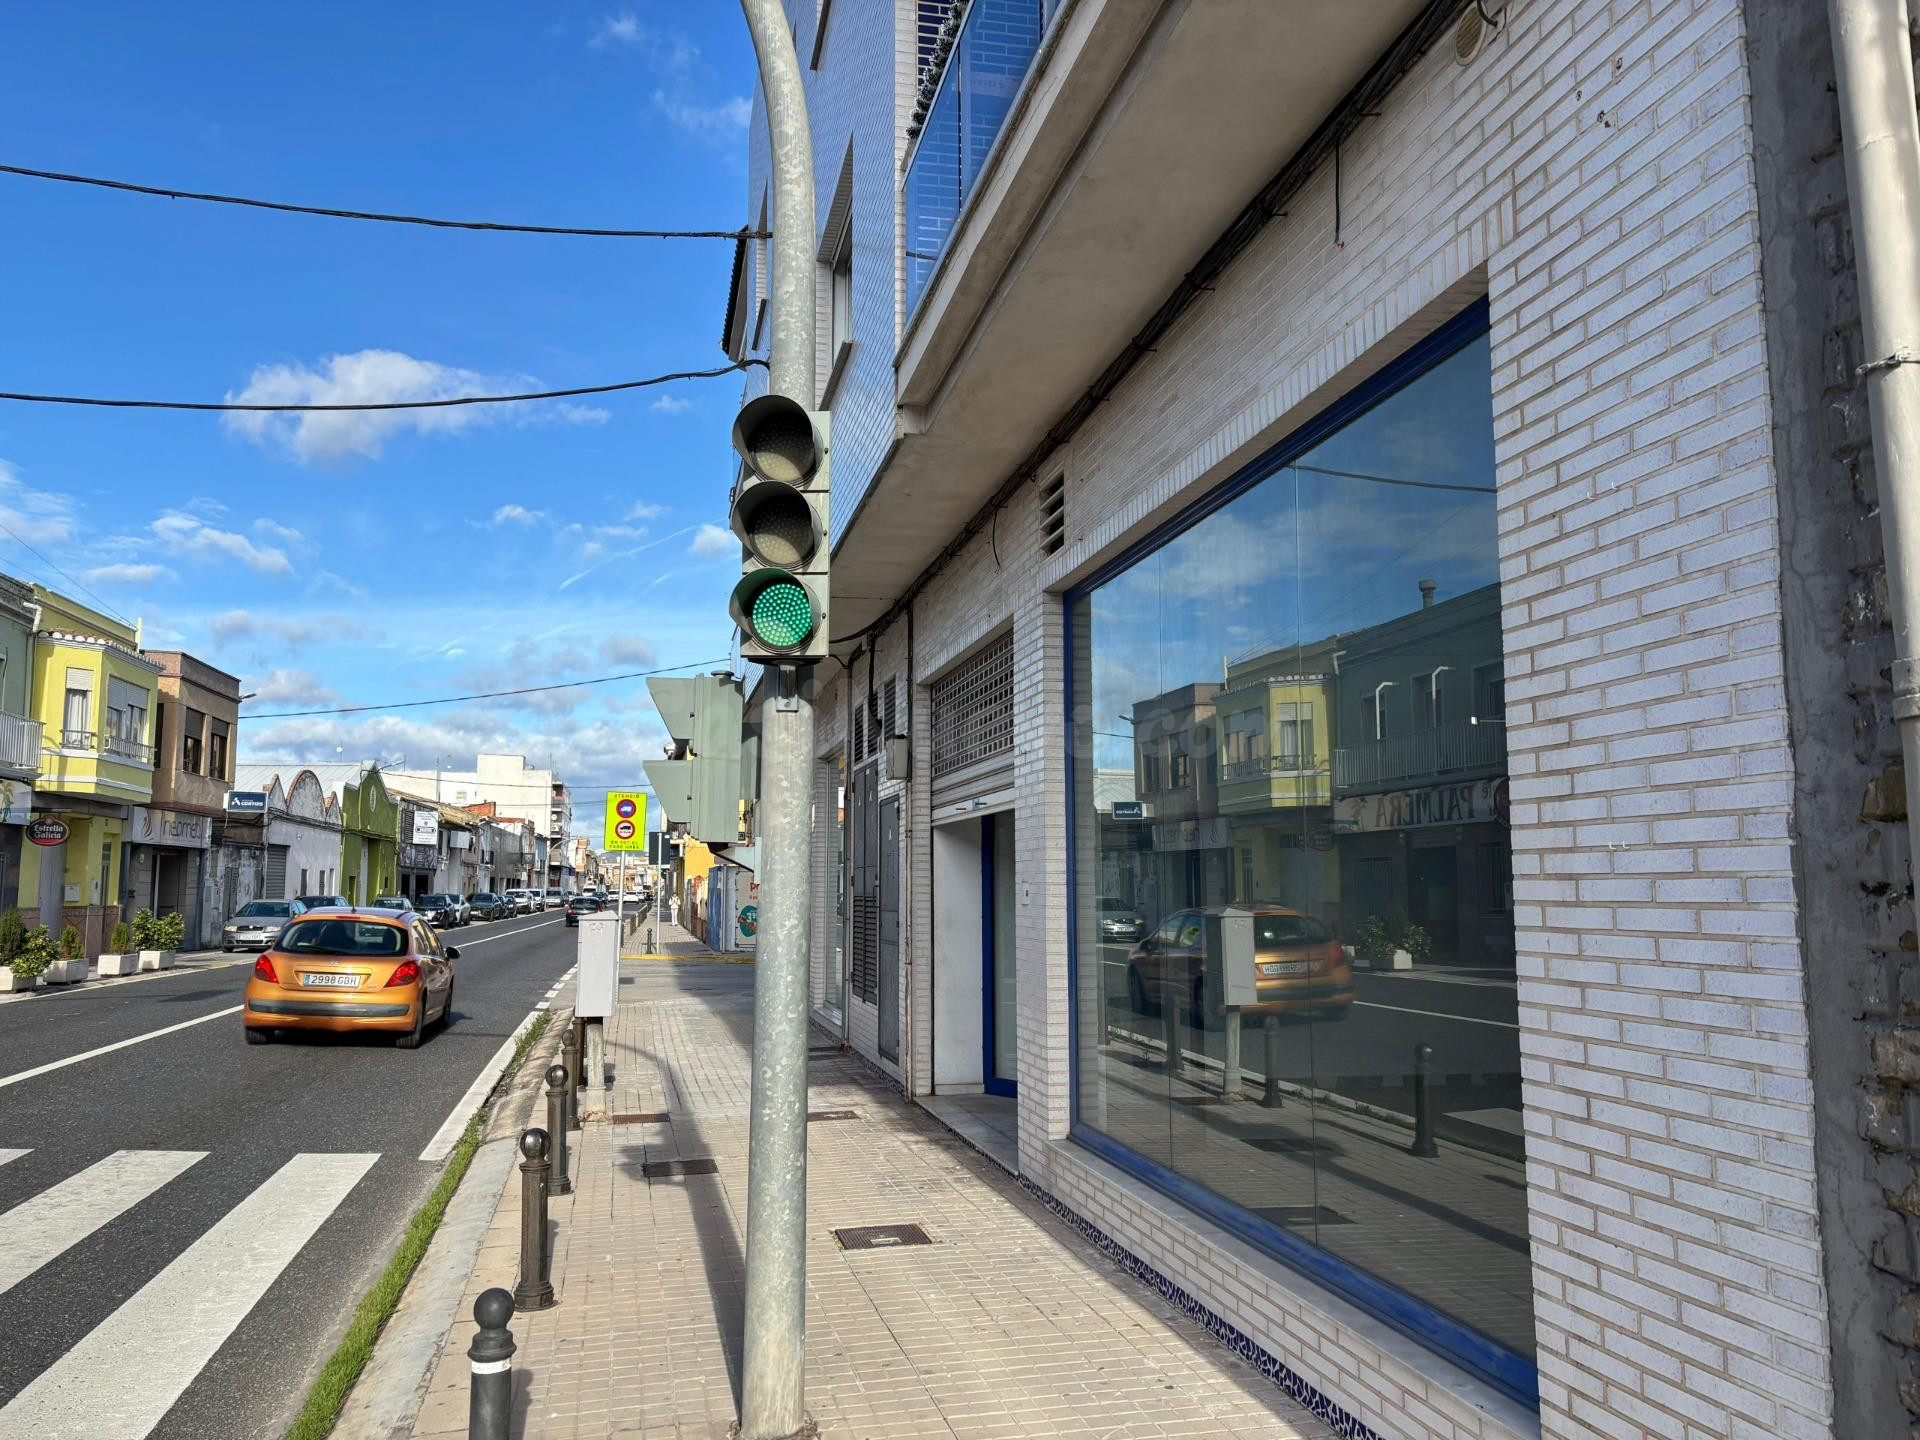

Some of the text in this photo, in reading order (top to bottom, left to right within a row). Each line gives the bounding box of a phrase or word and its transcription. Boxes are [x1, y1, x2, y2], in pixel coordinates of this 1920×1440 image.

[34, 824, 64, 832] Estrella
[34, 831, 62, 839] Galicia
[311, 975, 336, 985] 2998
[337, 976, 357, 986] GBH
